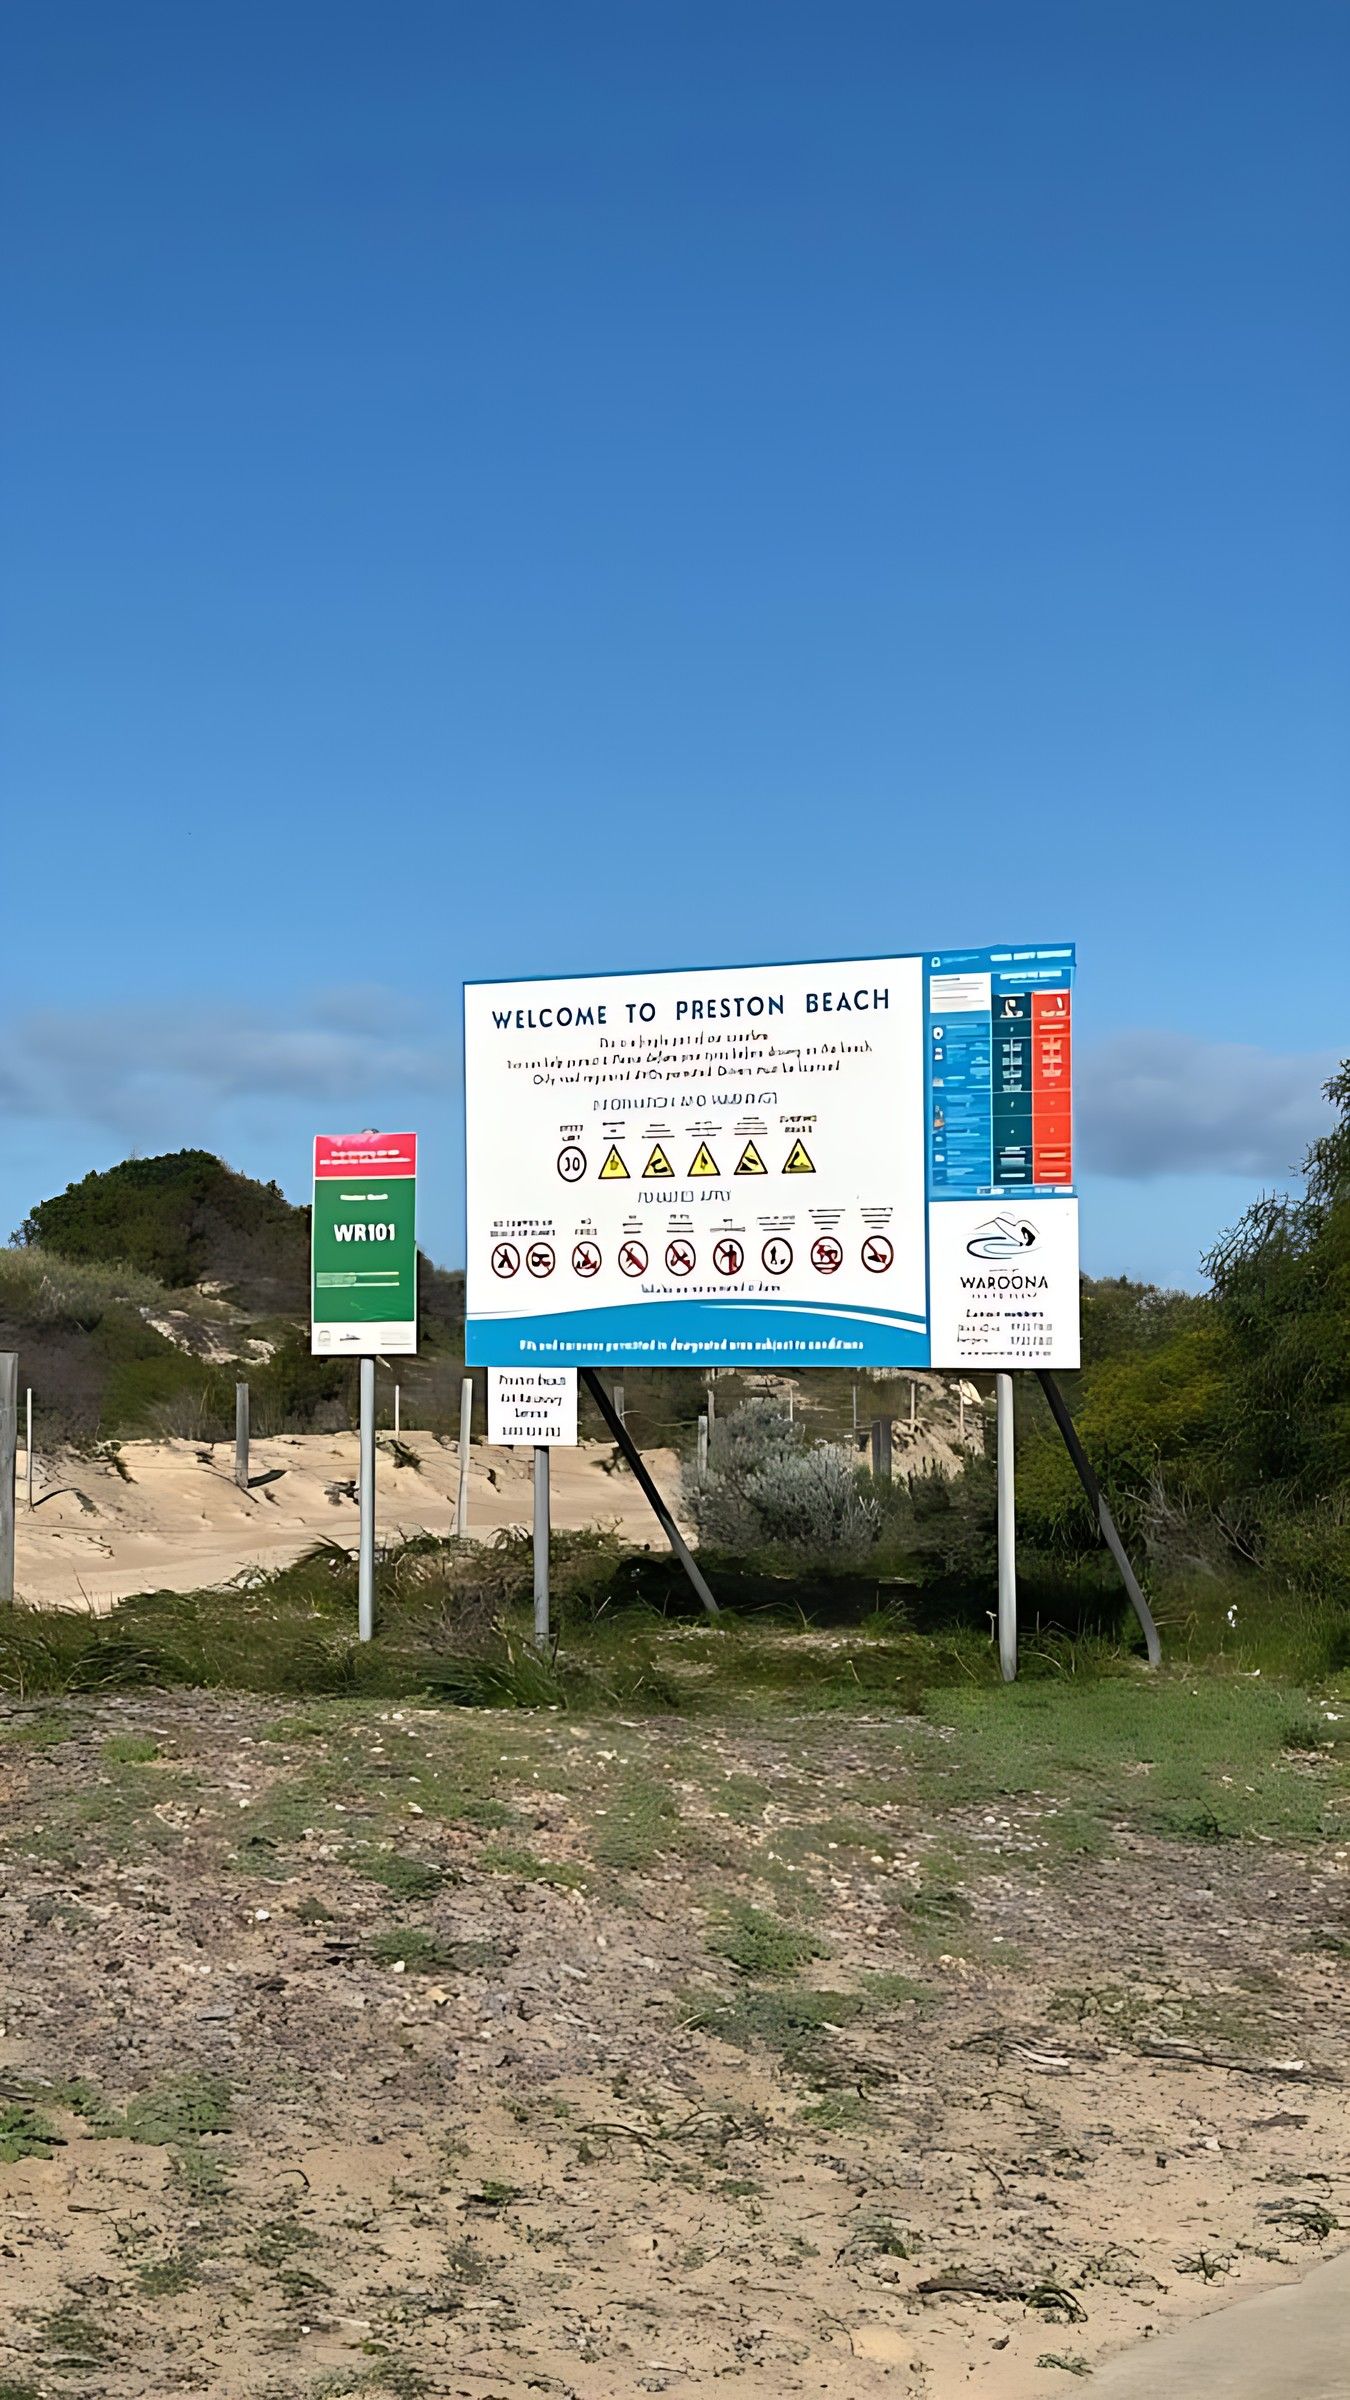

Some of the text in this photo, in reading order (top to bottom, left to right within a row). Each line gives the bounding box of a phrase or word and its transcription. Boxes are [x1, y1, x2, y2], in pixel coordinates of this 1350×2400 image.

[492, 988, 890, 1029] WELCOME TO PRESTON BEACH
[333, 1223, 396, 1243] WR101
[960, 1275, 1048, 1290] WAROONA
